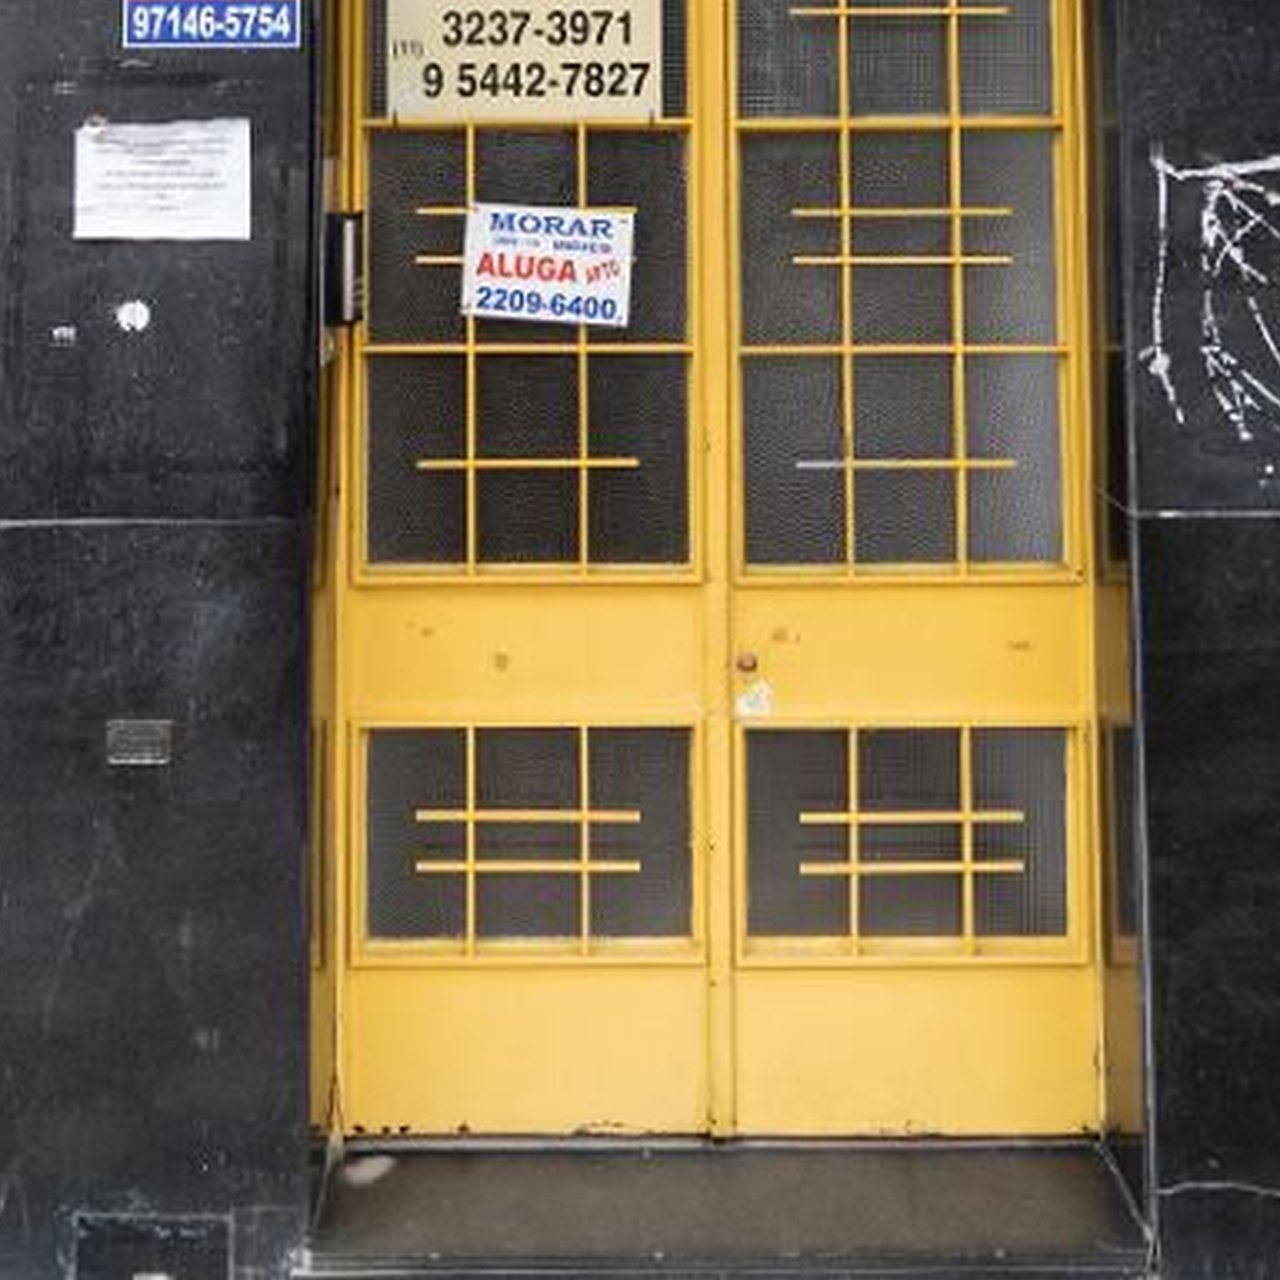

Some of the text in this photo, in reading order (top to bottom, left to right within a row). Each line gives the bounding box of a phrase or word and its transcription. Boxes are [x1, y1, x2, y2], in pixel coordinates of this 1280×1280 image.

[132, 4, 291, 39] 97146-5754
[442, 10, 632, 46] 3237-3971
[423, 63, 651, 97] 9 5442-7827
[489, 212, 614, 238] MORAR
[476, 252, 577, 282] ALUGA
[476, 286, 618, 319] 2209-6400
